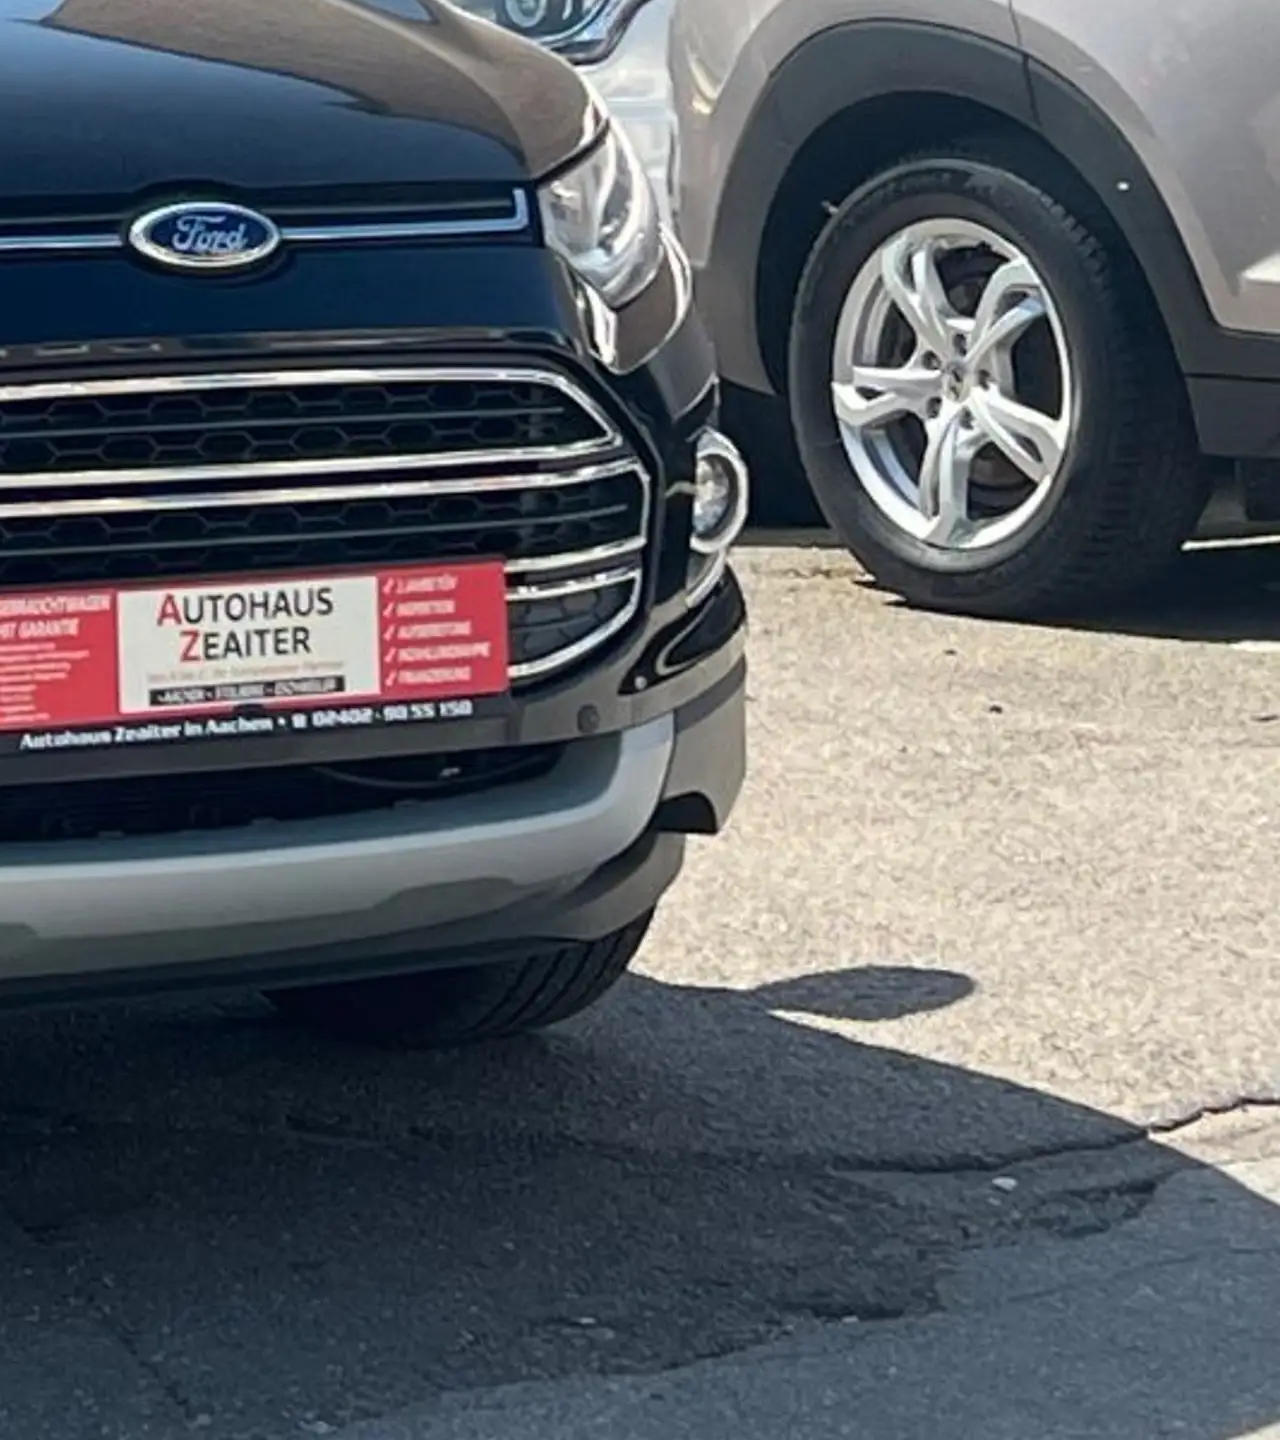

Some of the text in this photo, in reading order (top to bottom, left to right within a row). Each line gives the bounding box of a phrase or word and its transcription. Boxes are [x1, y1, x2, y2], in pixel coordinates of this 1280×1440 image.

[172, 215, 249, 252] Ford
[157, 587, 334, 627] AUTOHAUS
[179, 626, 311, 662] ZEAITER
[20, 728, 112, 750] Autohaus
[115, 722, 182, 739] Zeaiter
[184, 720, 203, 736] in
[205, 716, 273, 735] Aachen
